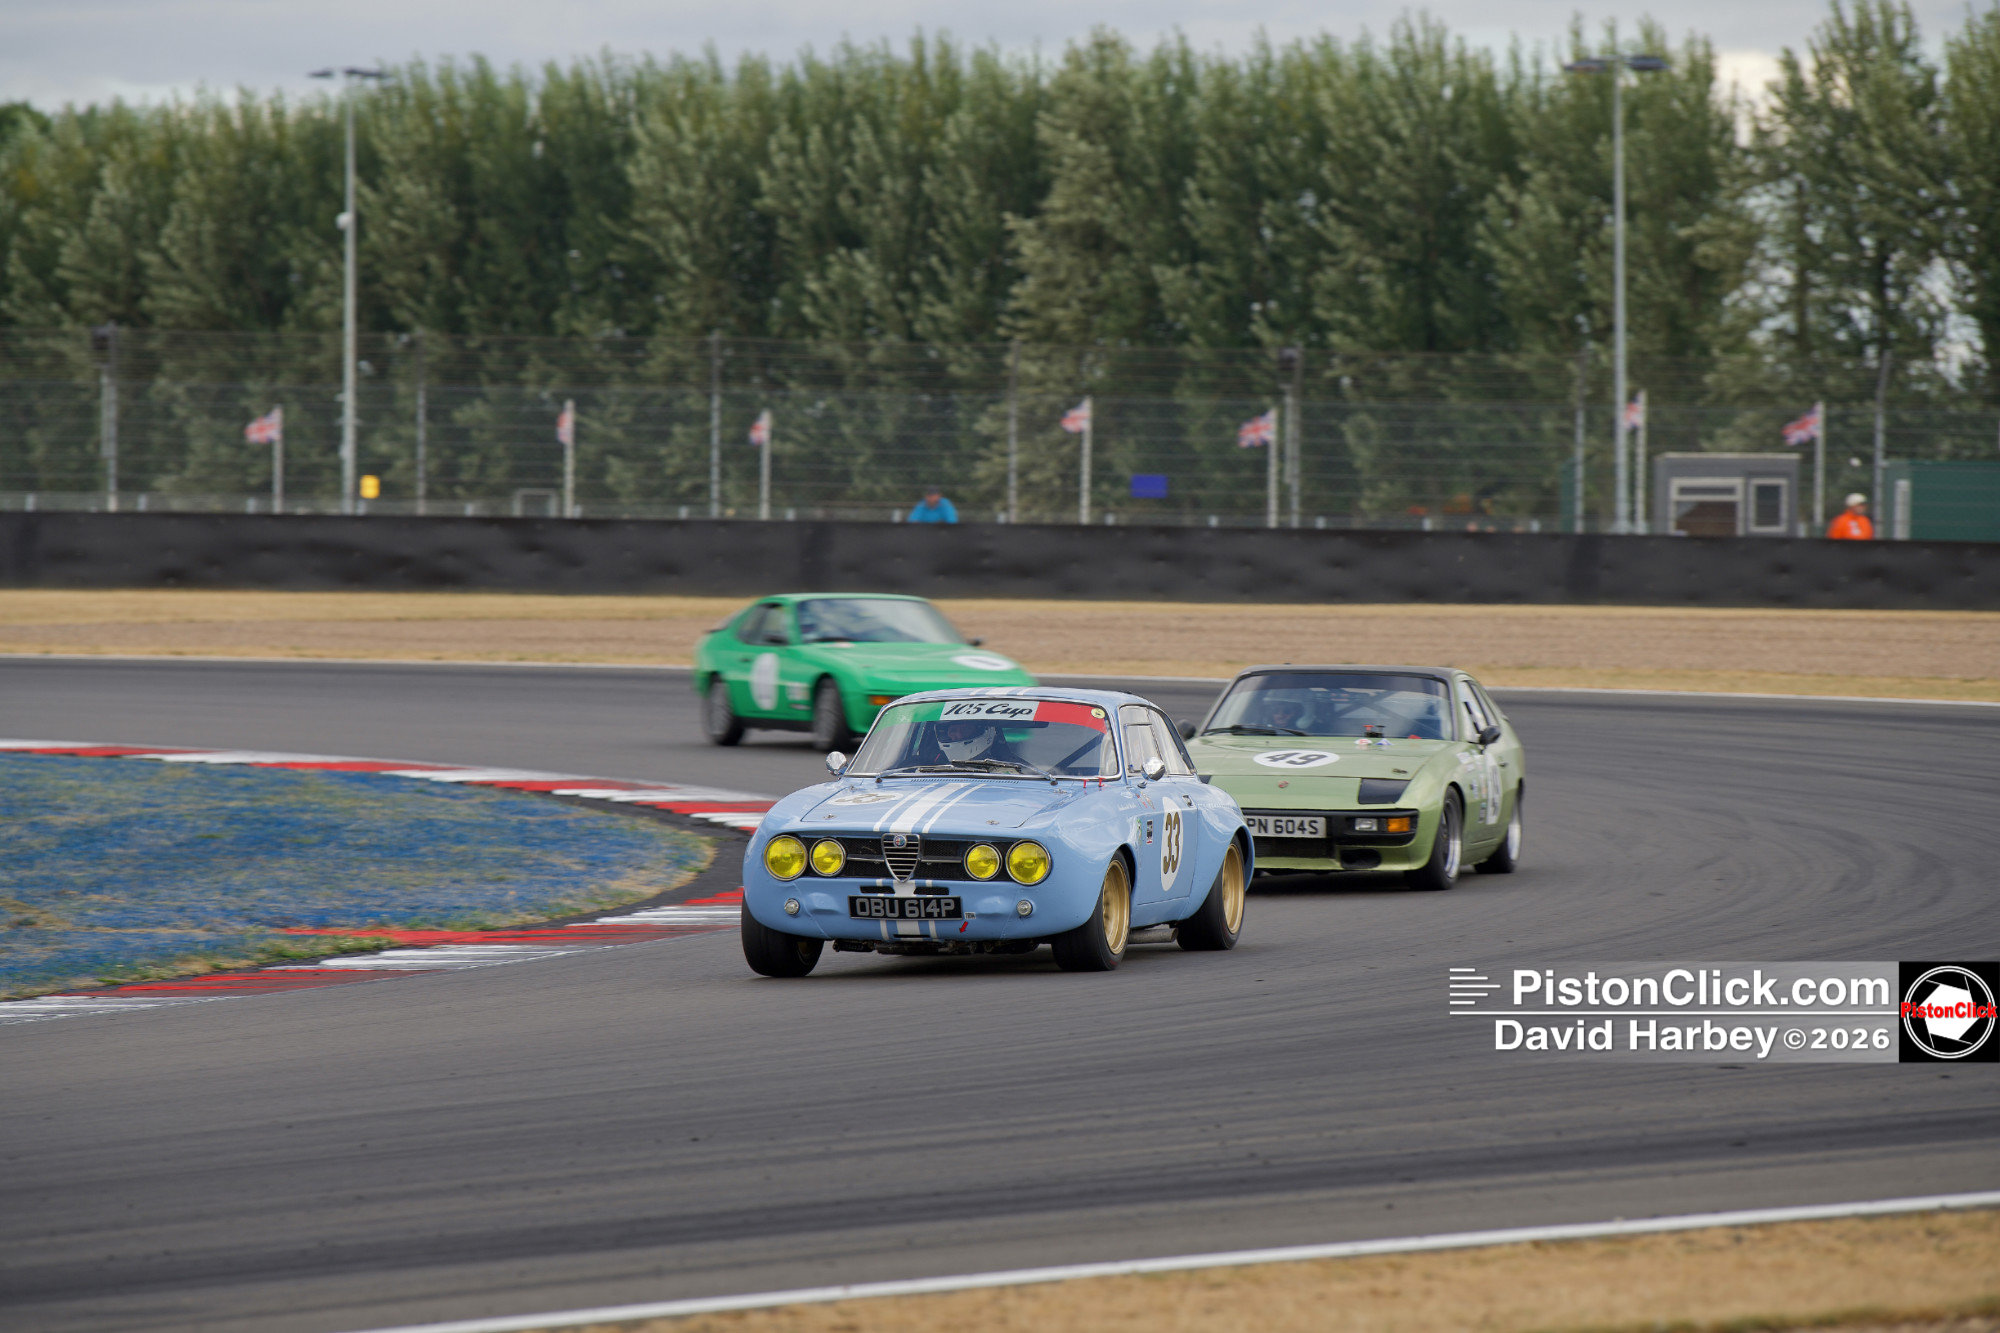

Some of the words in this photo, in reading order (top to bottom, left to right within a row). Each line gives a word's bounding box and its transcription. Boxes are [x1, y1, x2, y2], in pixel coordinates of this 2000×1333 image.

[944, 703, 986, 716] 105
[986, 703, 1033, 718] Cup
[1265, 752, 1328, 765] 49
[1246, 818, 1268, 834] PN
[1274, 819, 1319, 835] 604S
[1162, 811, 1181, 875] 33
[855, 897, 900, 918] OBU
[904, 898, 955, 918] 614P
